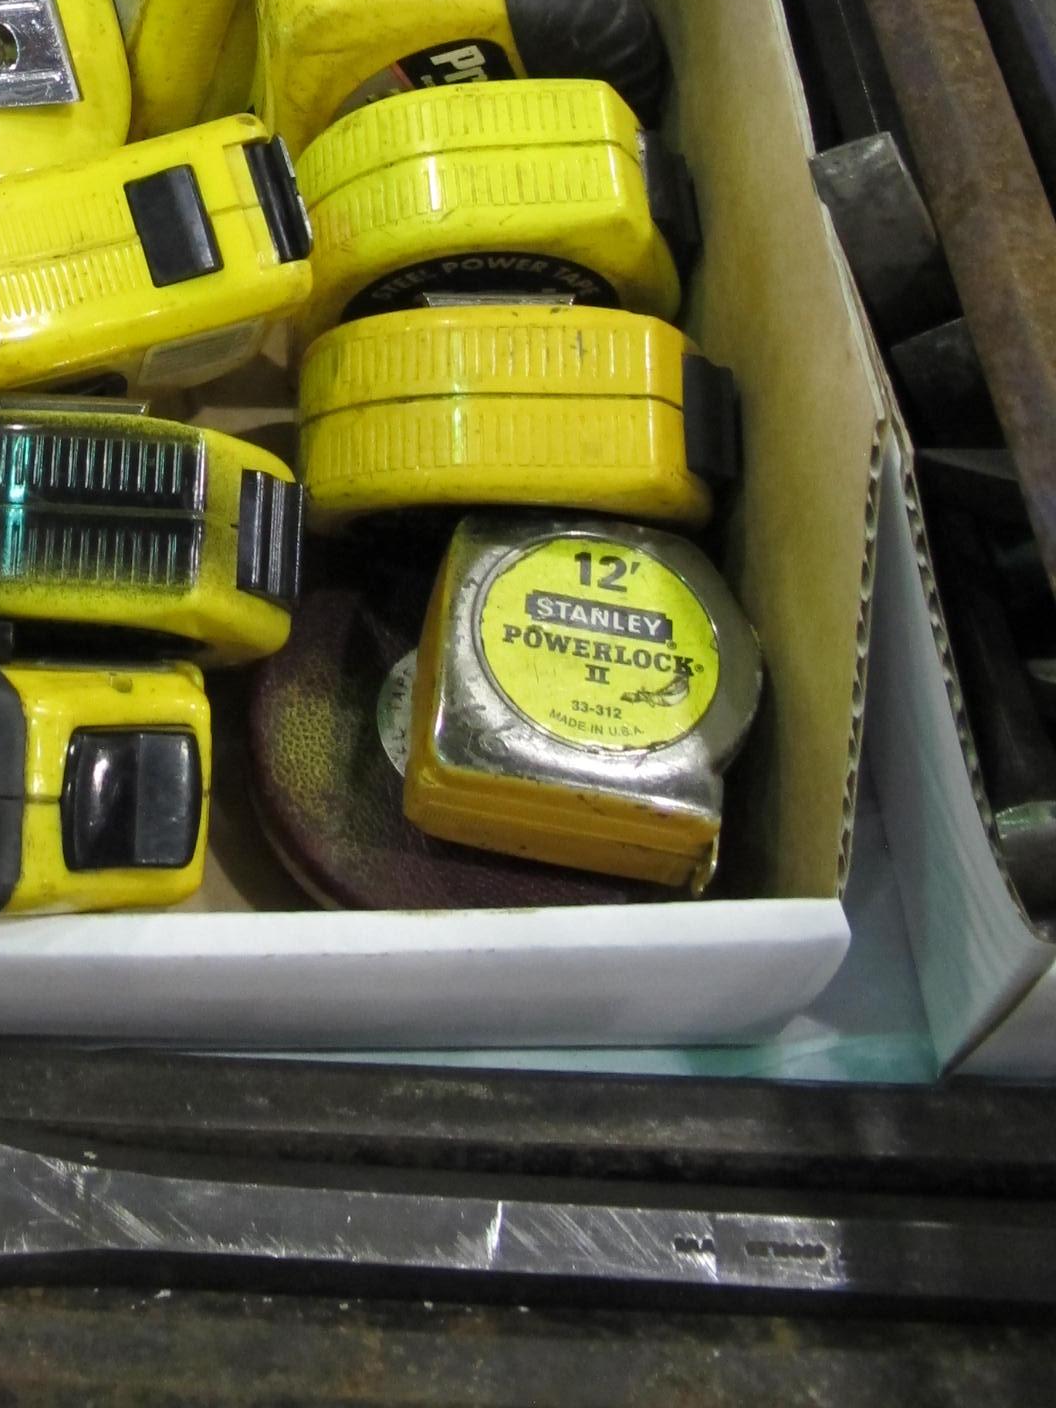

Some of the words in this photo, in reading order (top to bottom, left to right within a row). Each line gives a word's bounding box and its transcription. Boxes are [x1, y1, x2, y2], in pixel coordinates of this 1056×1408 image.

[442, 257, 548, 274] POWER
[537, 596, 662, 637] STANLEY
[503, 623, 694, 677] POWERLOCK
[585, 664, 610, 685] II
[571, 699, 623, 720] 33-312
[549, 708, 586, 731] MADE
[591, 724, 604, 736] IN
